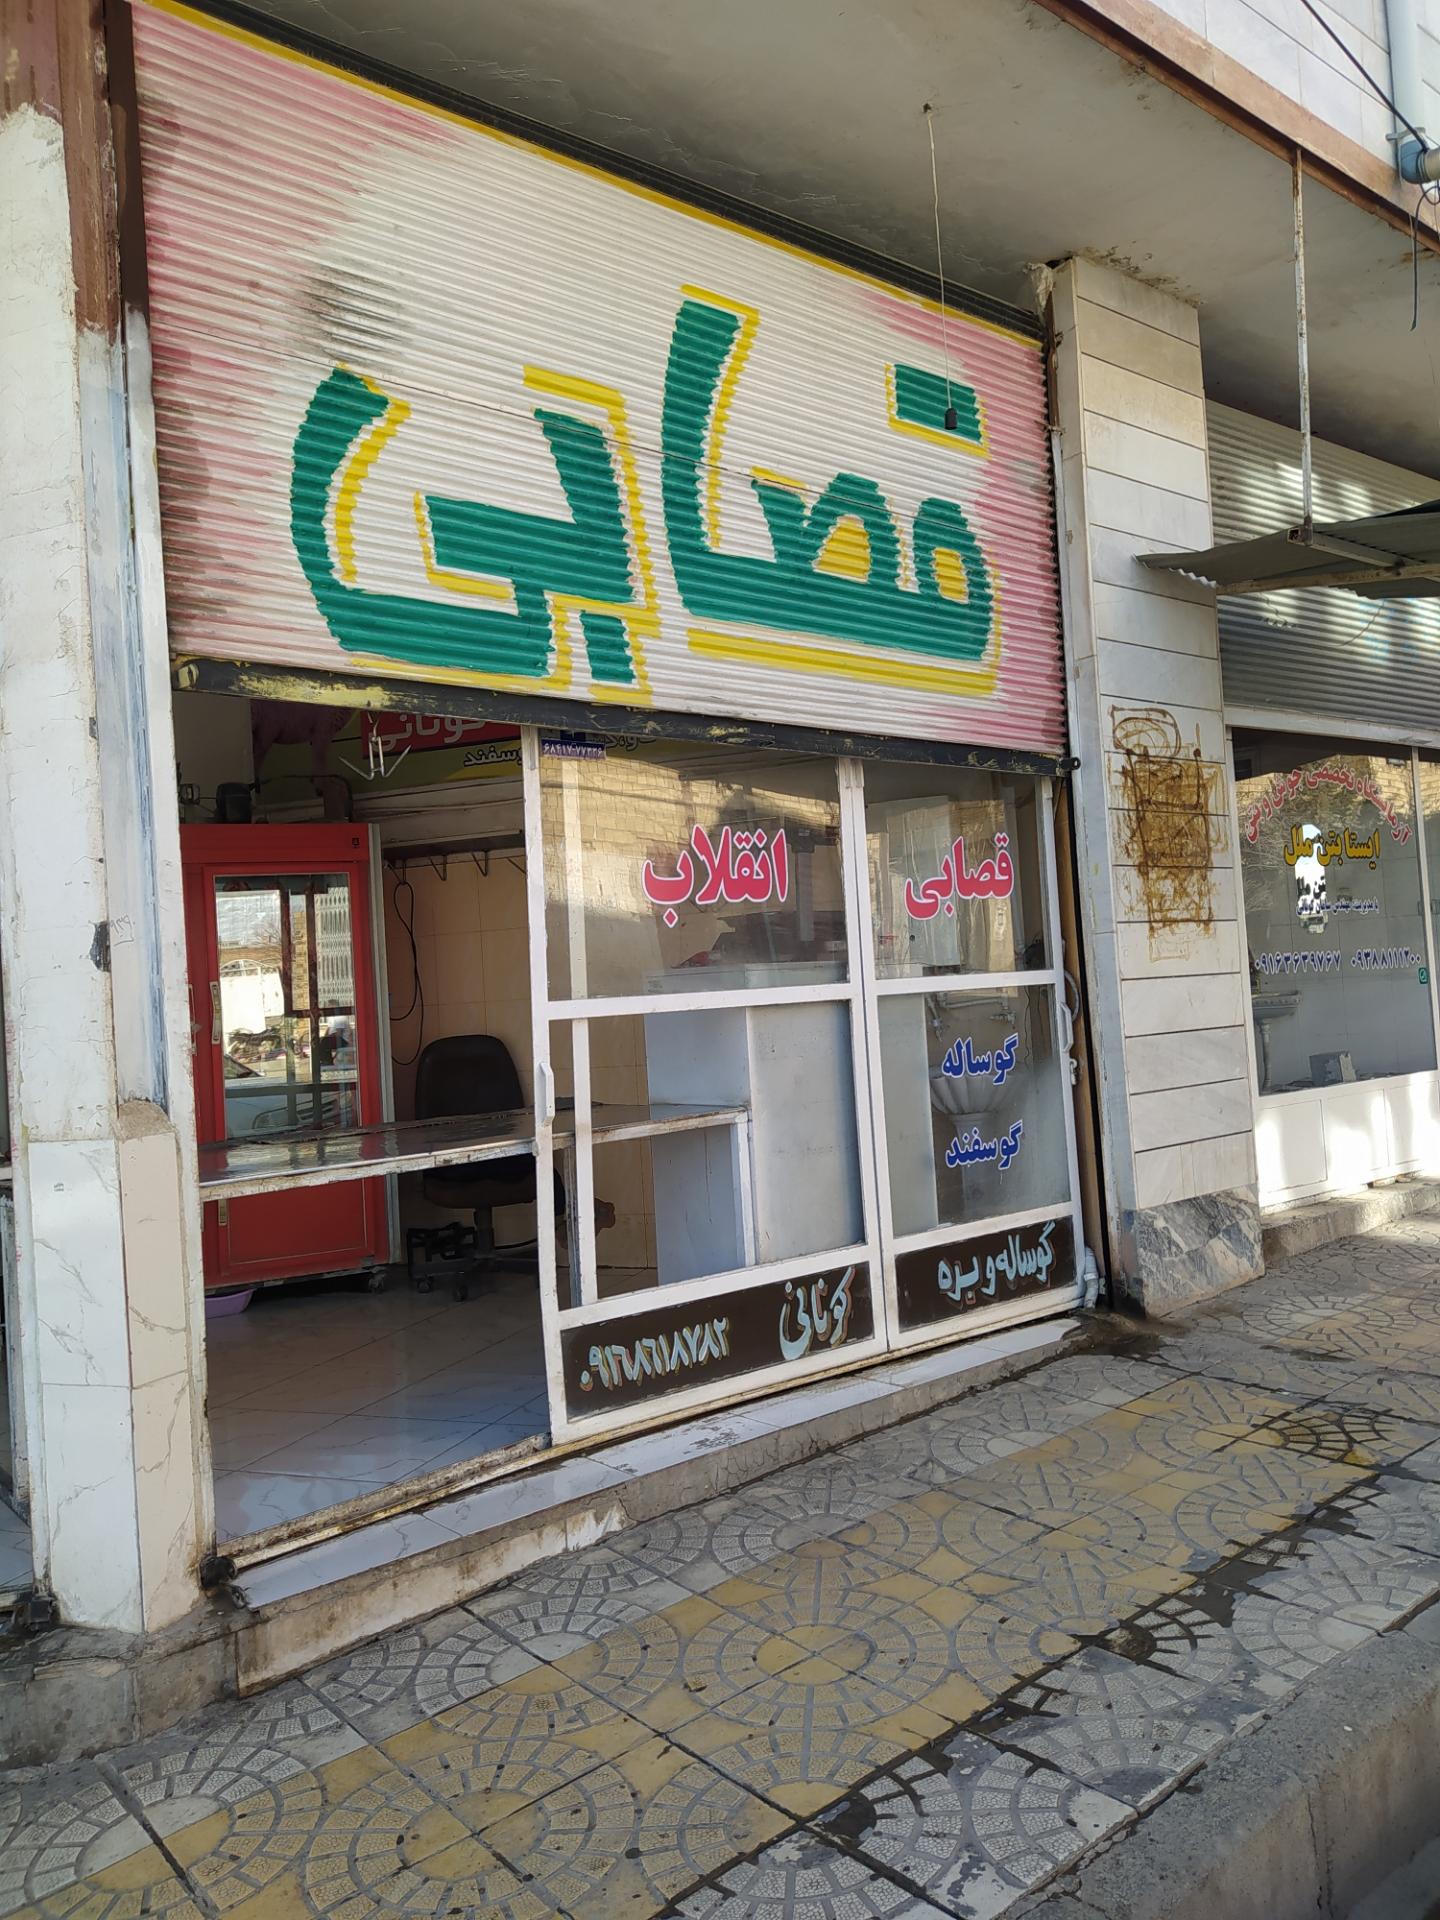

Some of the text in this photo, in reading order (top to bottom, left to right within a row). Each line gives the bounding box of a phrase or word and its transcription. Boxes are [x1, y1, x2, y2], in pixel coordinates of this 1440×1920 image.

[291, 290, 1000, 702] قصابی
[642, 823, 1014, 928] قصابی انقلاب
[1284, 824, 1380, 870] ایستا بتن ملل
[942, 1032, 1019, 1085] گوساله
[945, 1119, 1023, 1169] گوسفند
[938, 1220, 1056, 1304] گوساله و بره
